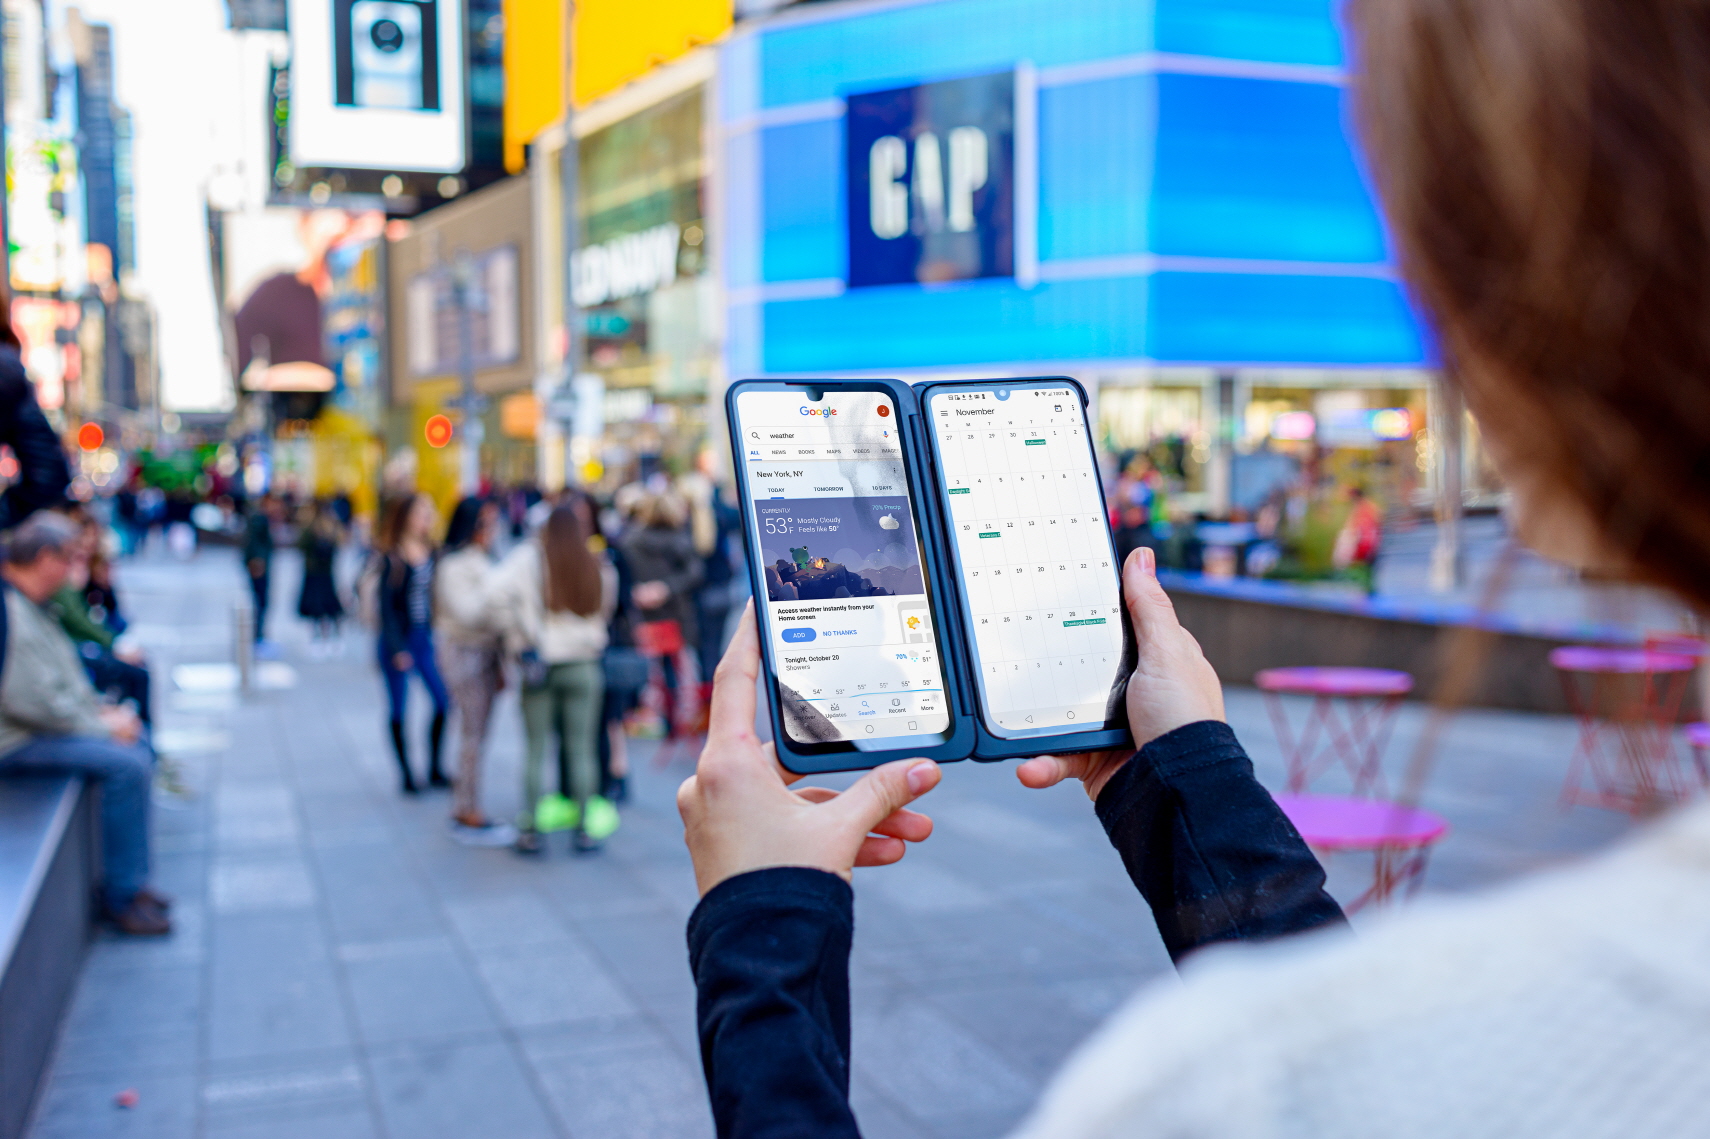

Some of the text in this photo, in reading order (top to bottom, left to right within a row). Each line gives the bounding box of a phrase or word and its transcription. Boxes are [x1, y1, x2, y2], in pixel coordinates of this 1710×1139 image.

[869, 125, 988, 240] GAP
[800, 406, 837, 418] Google
[956, 408, 995, 416] November
